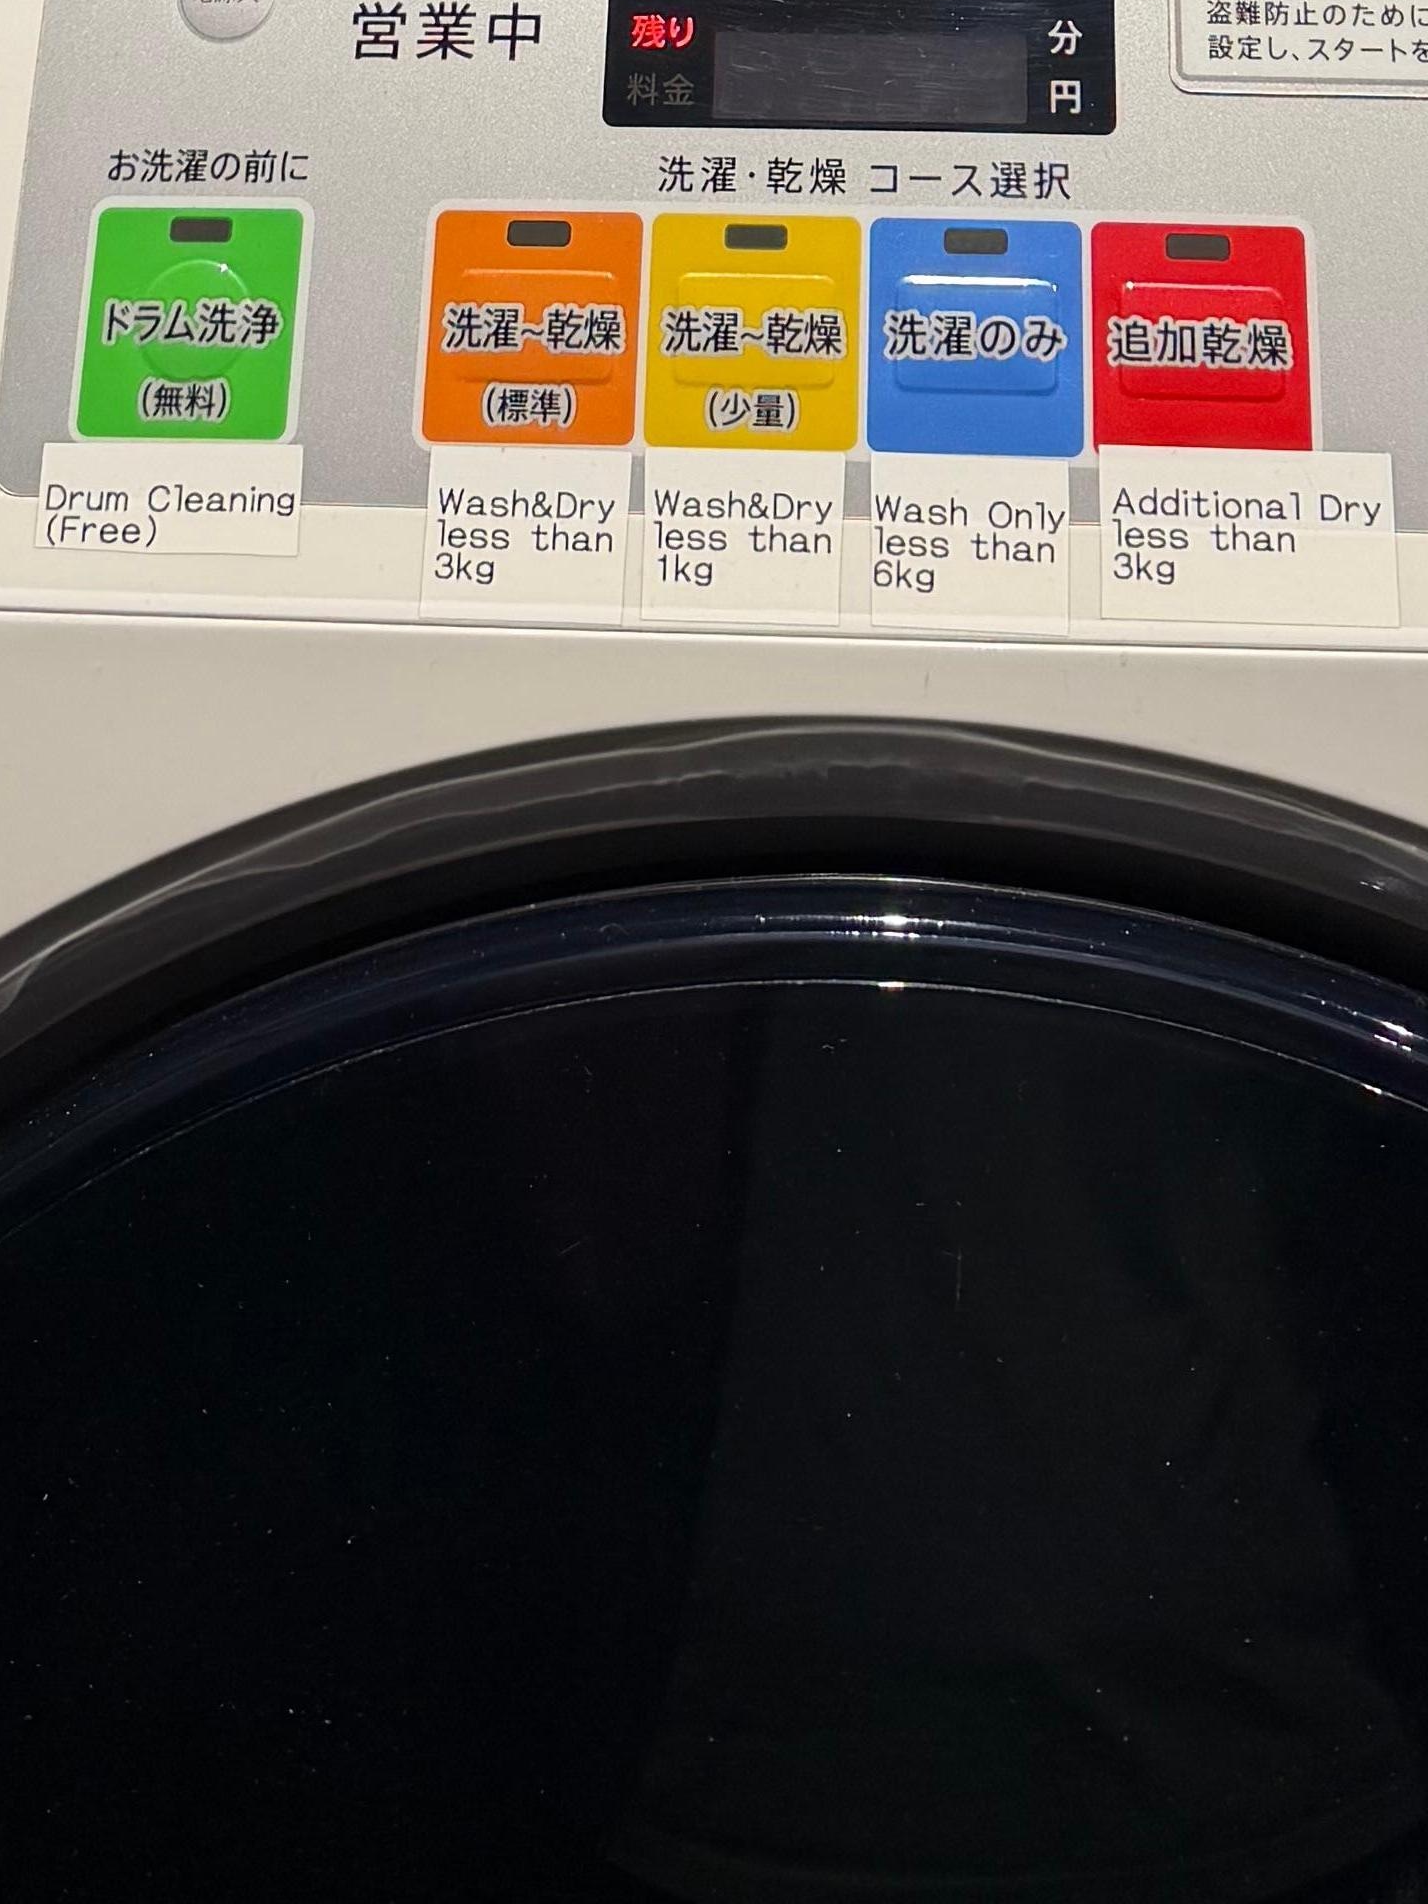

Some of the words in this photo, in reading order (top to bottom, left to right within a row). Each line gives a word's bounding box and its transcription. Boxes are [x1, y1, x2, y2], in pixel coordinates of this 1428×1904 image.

[352, 2, 544, 62] 営業中
[630, 14, 695, 49] 残り
[1048, 20, 1082, 55] 分
[1049, 79, 1082, 114] 円
[107, 149, 310, 184] お洗濯の前に
[868, 162, 1073, 201] コース選択
[102, 303, 280, 345] ドラム洗浄
[886, 313, 1064, 357] 洗濯のみ
[1109, 323, 1290, 367] 追加乾燥
[140, 383, 229, 421] (無料)
[484, 389, 575, 425] (標準)
[706, 393, 798, 432] (少量)
[45, 484, 126, 514] Drum
[147, 485, 296, 517] Cleaning
[437, 488, 616, 525] Wash&Dry
[652, 490, 832, 525] Wash&Dry
[873, 493, 970, 528] Wash
[987, 500, 1065, 533] Only
[1112, 487, 1302, 522] Additional
[1318, 493, 1382, 528] Dry
[44, 514, 159, 546] (Free)
[437, 522, 511, 552] less
[532, 524, 615, 554] than
[654, 519, 729, 553] less
[747, 524, 833, 556] than
[873, 527, 952, 560] less
[970, 532, 1057, 564] than
[1112, 519, 1189, 551] less
[1207, 524, 1296, 554] than
[434, 553, 497, 586] 3kg
[657, 555, 715, 588] 1kg
[872, 562, 938, 594] 6kg
[1112, 555, 1177, 587] 3kg
